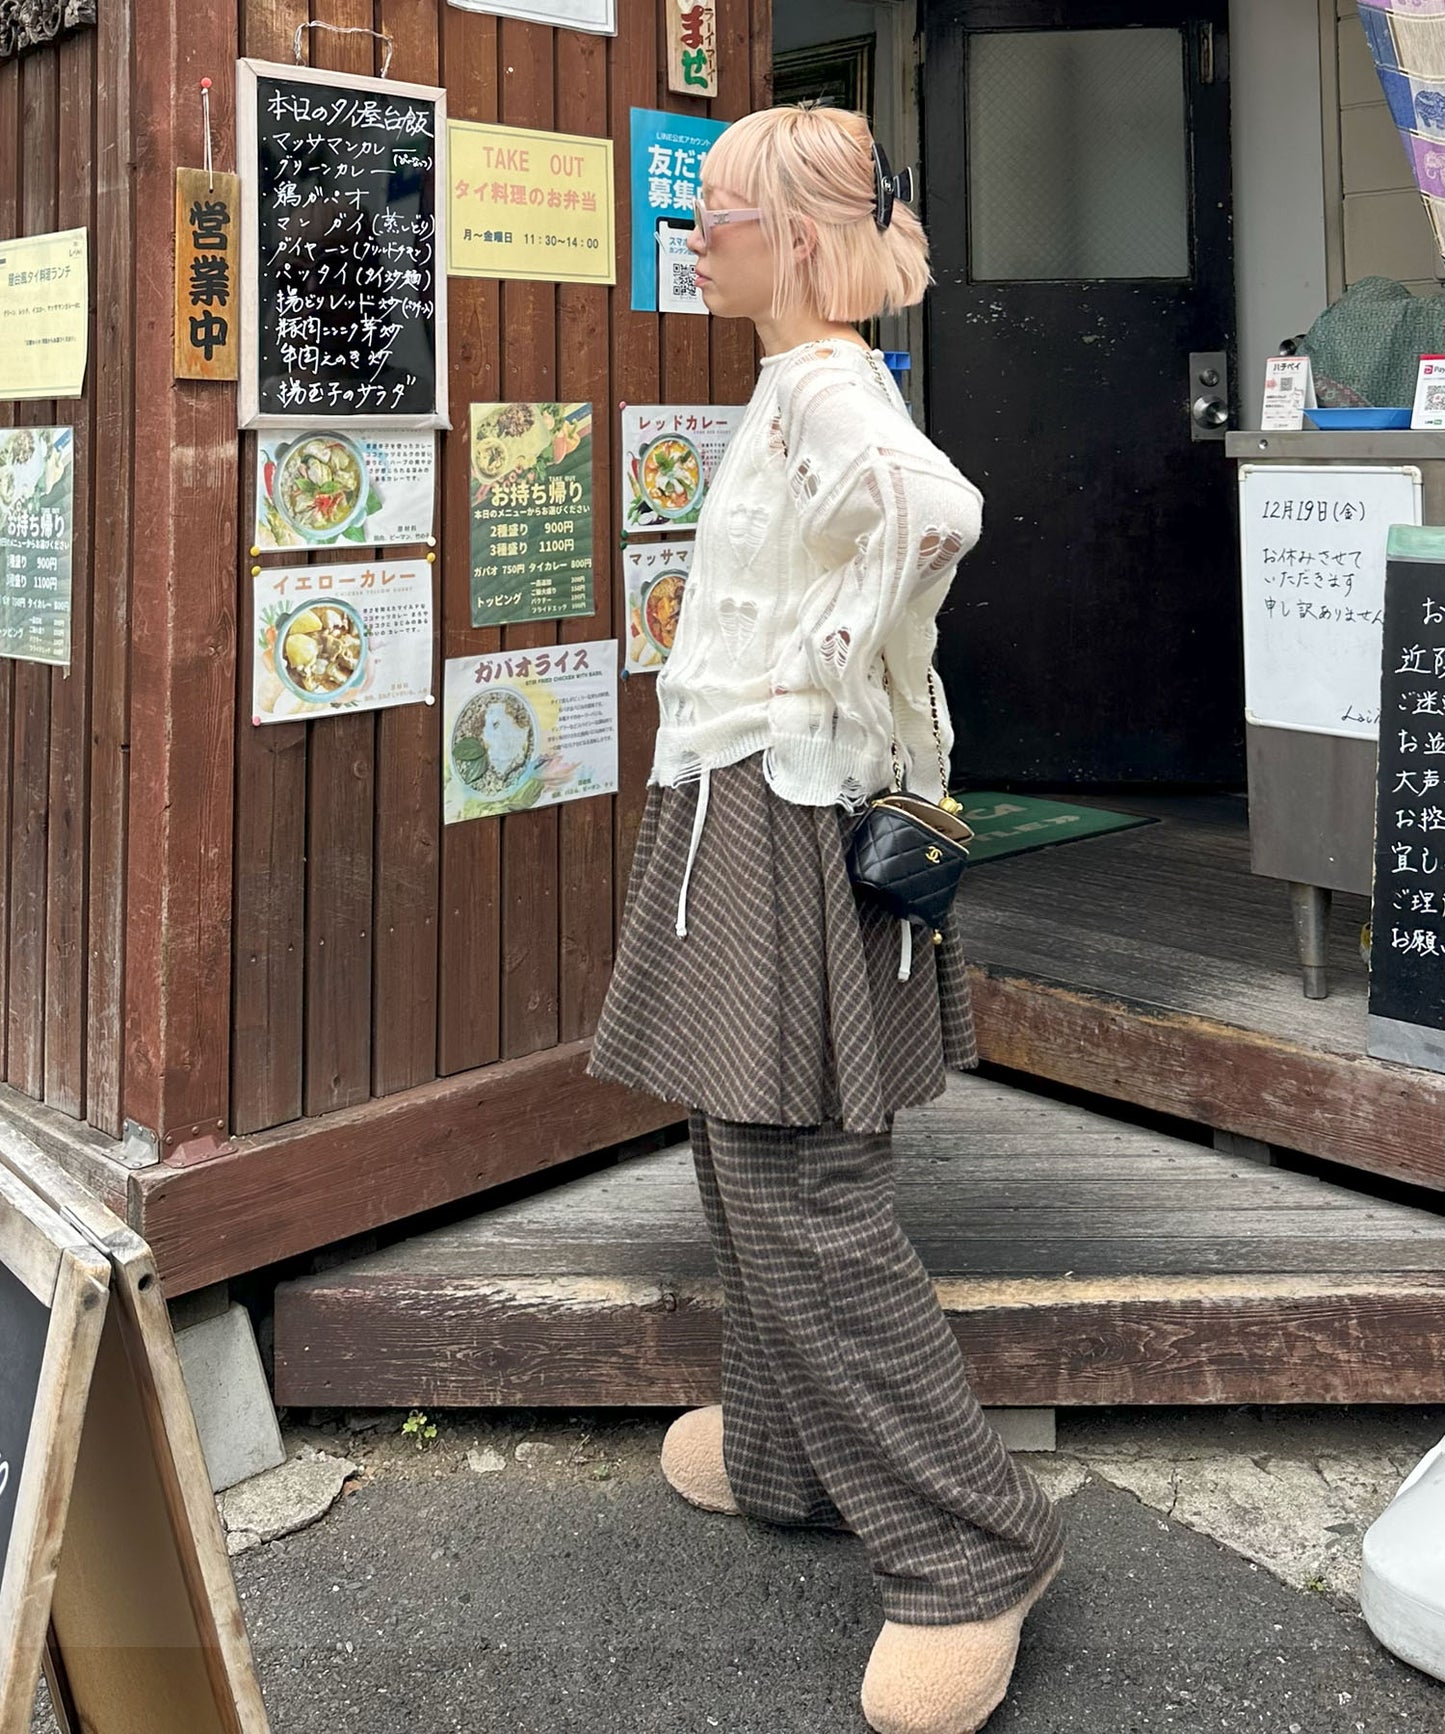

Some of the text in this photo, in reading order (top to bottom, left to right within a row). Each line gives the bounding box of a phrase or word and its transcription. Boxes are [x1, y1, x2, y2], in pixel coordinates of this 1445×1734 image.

[676, 0, 709, 89] ませ
[267, 89, 435, 140] 本日のタイ屋台飯
[273, 155, 397, 180] グリーンカレー
[483, 147, 584, 177] TAKE OUT
[455, 179, 597, 212] タイ料理のお弁当
[648, 177, 703, 211] 募集
[188, 200, 231, 361] 営業中
[639, 415, 728, 431] レッドカレー
[491, 480, 583, 507] お持ち帰り
[8, 510, 64, 538] お持ち帰り
[474, 505, 591, 520] 本日のメニューからお選びください
[1261, 500, 1366, 522] 12月19日(金)
[490, 520, 574, 538] 2種盛り 900円
[489, 538, 575, 557] 3種盛り 1100円
[1263, 547, 1362, 569] お休みさせて
[273, 569, 416, 595] イエローカレー
[474, 565, 498, 577] ガパオ
[502, 563, 525, 575] 750円
[529, 561, 568, 573] タイカレー
[1263, 568, 1356, 598] いただきます
[477, 592, 523, 609] トッピング
[1398, 690, 1445, 716] ご迷
